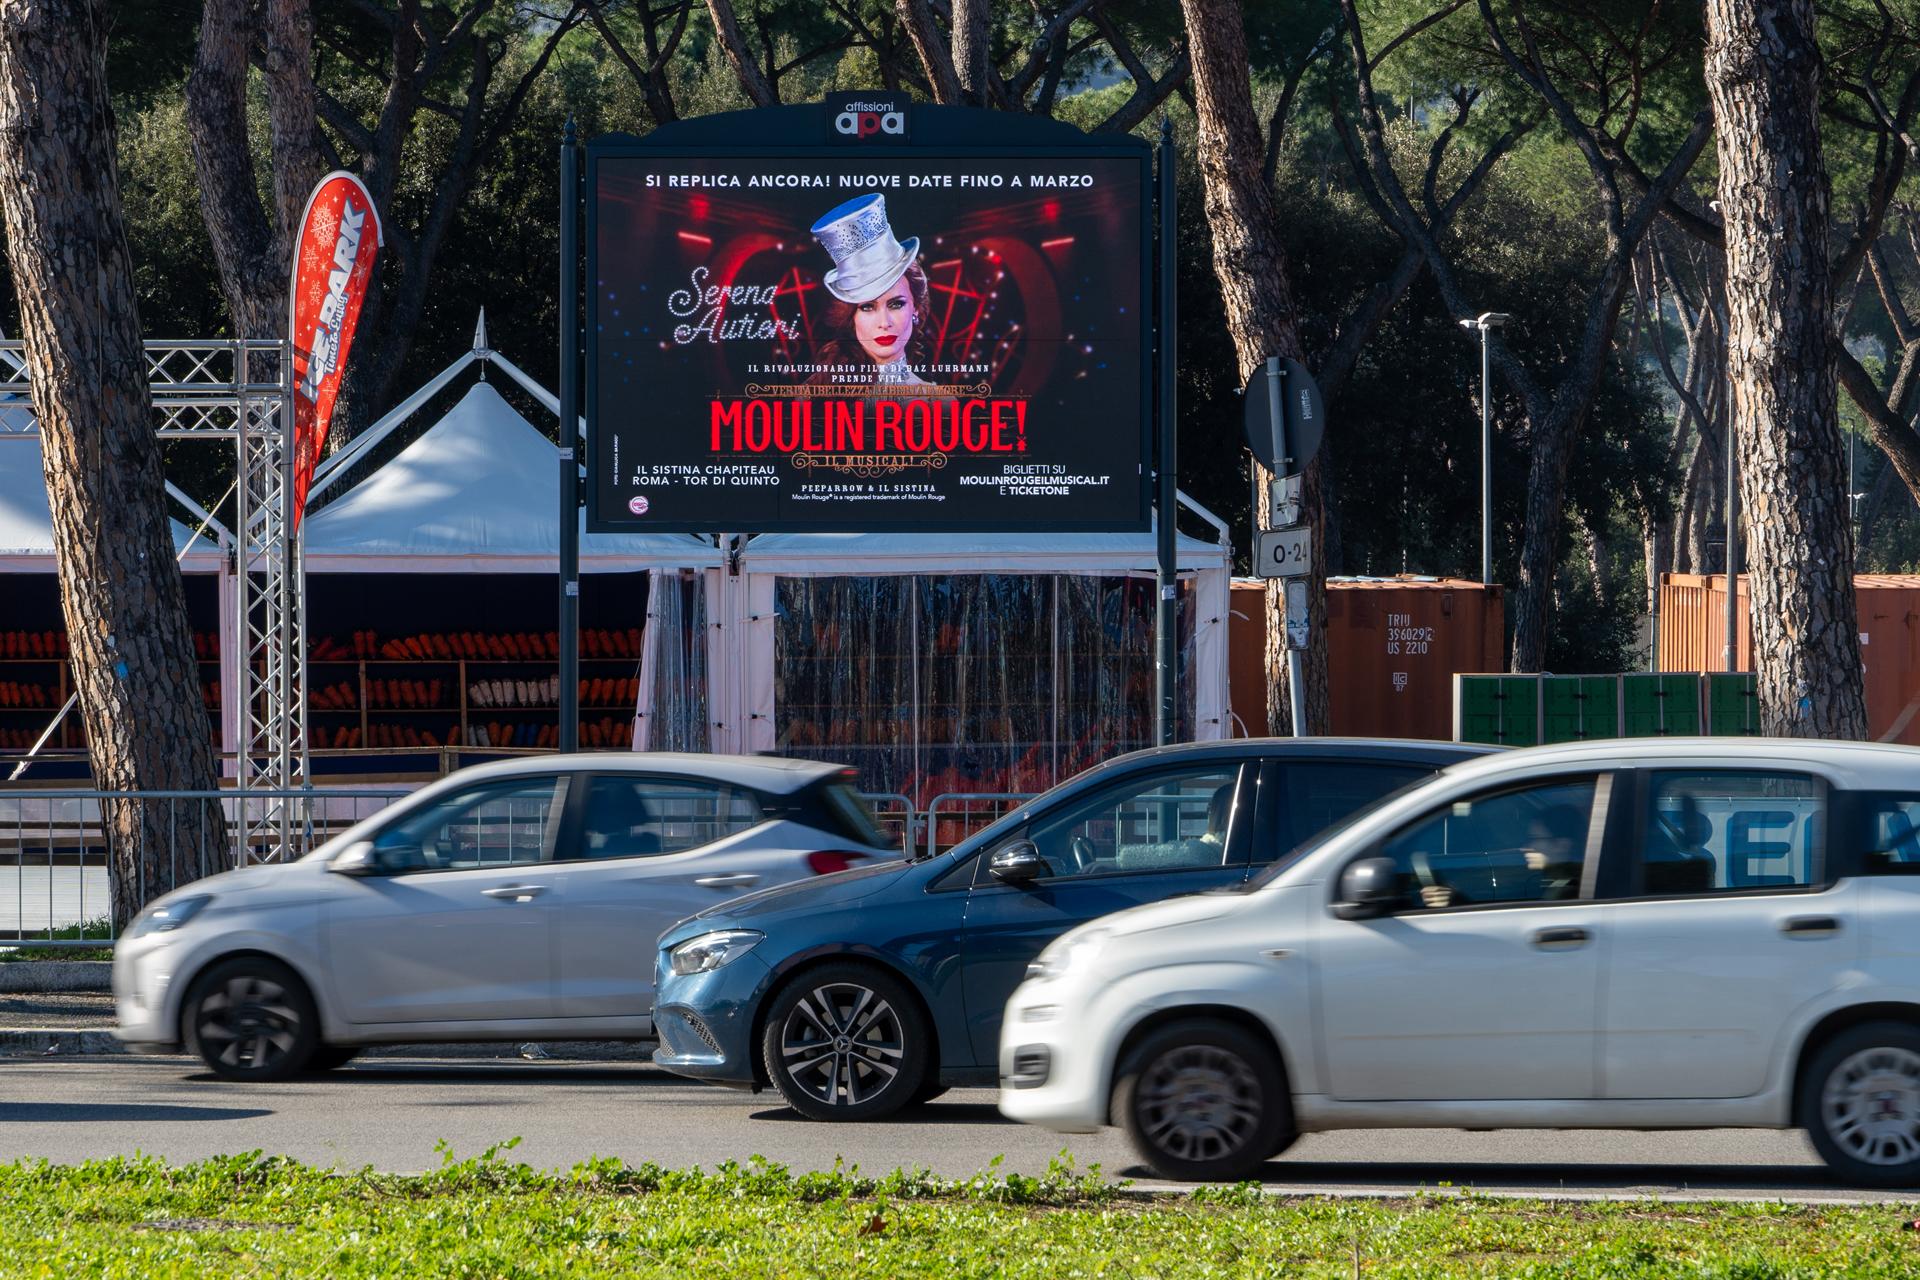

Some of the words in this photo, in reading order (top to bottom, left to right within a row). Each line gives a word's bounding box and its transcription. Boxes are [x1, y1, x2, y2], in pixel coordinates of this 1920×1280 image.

[845, 102, 894, 112] affissioni
[835, 112, 904, 138] apa
[646, 174, 660, 187] SI
[669, 174, 741, 187] REPLICA
[748, 174, 830, 187] ANCORA!
[839, 174, 900, 187] NUOVE
[909, 174, 953, 187] DATE
[961, 174, 1002, 187] FINO
[1011, 174, 1023, 187] A
[1031, 174, 1094, 187] MARZO
[668, 266, 778, 316] Serena
[300, 327, 331, 403] ICE
[319, 198, 366, 324] PARK
[674, 307, 801, 344] Autieri
[748, 364, 759, 373] IL
[764, 364, 855, 373] RIVOLUZIONARIO
[861, 364, 886, 373] FILM
[890, 364, 901, 373] DI
[906, 364, 926, 373] BAZ
[931, 364, 989, 373] LUHRMANN
[831, 374, 873, 383] PRENDE
[878, 374, 903, 383] VITA
[711, 399, 864, 452] MOULIN
[875, 399, 1027, 452] ROUGE!
[825, 455, 839, 467] IL
[637, 465, 648, 475] IL
[653, 465, 701, 475] SISTINA
[706, 465, 775, 475] CHAPITEAU
[1003, 464, 1050, 475] BIGLIETTI
[1053, 464, 1066, 475] SU
[632, 476, 670, 486] ROMA
[683, 476, 708, 486] TOR
[714, 476, 726, 486] DI
[730, 476, 780, 487] QUINTO
[959, 475, 1110, 485] MOULINROUGEILMUSICAL.IT
[801, 484, 863, 493] PEEPARROW
[868, 484, 874, 492] &
[879, 484, 890, 492] IL
[894, 484, 936, 492] SISTINA
[1000, 486, 1006, 496] E
[1009, 486, 1070, 496] TICKETONE
[791, 493, 811, 501] Moulin
[844, 493, 872, 502] registered
[872, 493, 900, 501] trademark
[908, 493, 927, 501] Moulin
[928, 493, 946, 502] Rouge
[1388, 614, 1410, 627] TRIU
[1388, 641, 1400, 655] US
[1405, 641, 1428, 655] 2210
